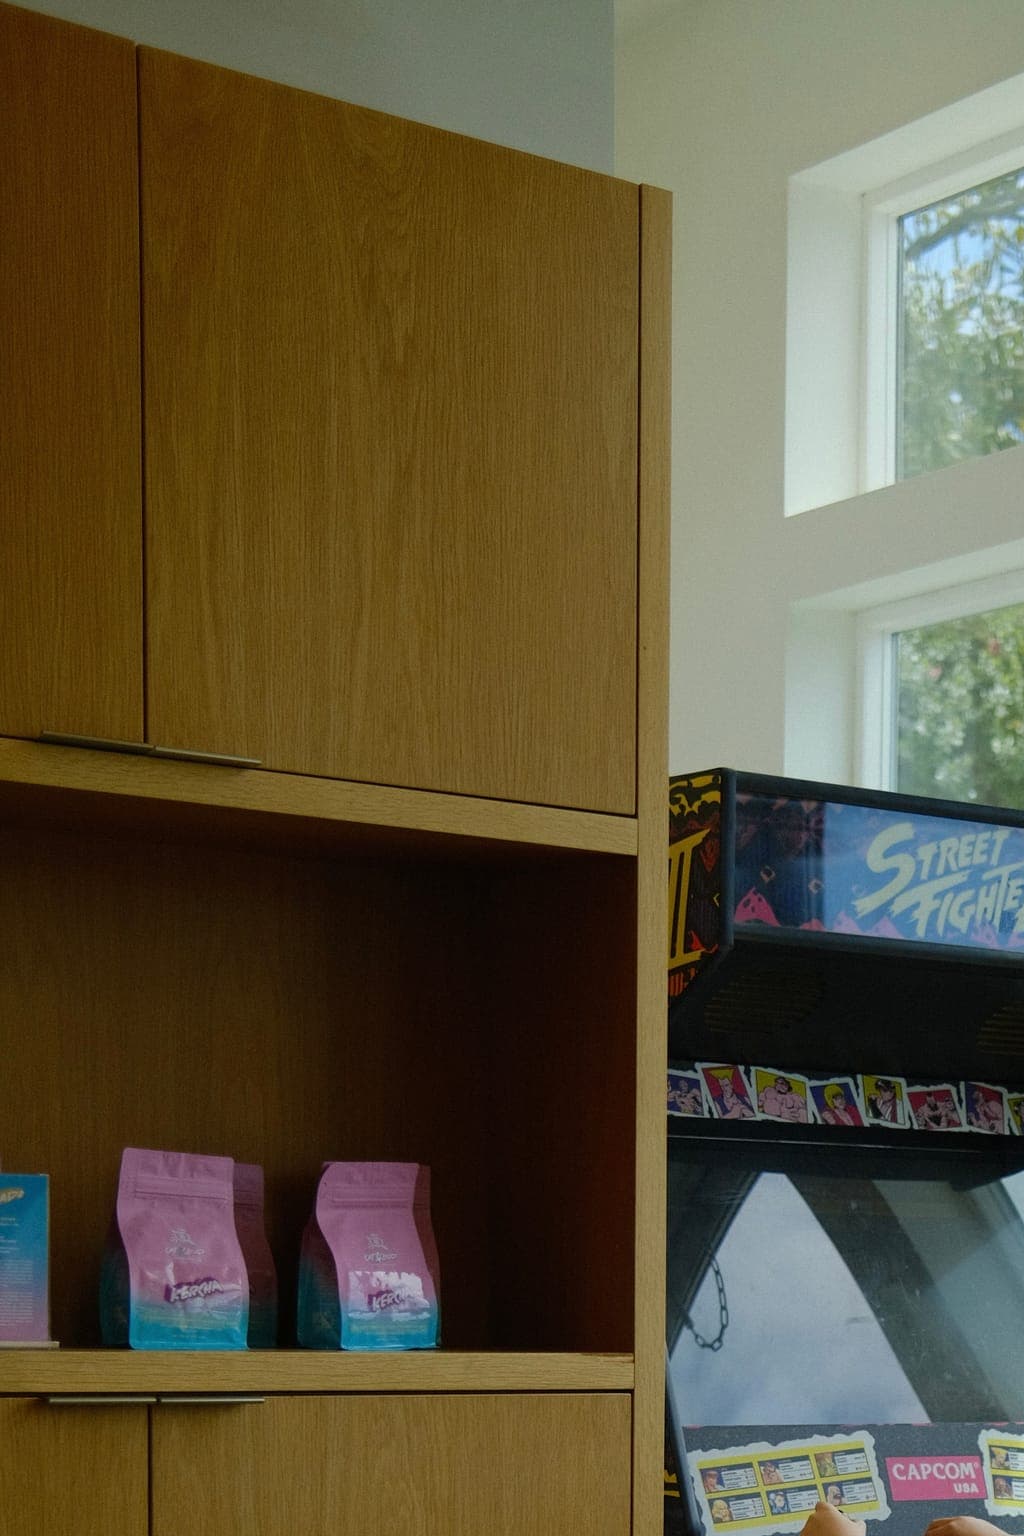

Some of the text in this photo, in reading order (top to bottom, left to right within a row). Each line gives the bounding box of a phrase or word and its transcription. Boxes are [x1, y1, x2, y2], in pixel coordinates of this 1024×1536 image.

[852, 822, 1012, 919] STREET
[892, 1462, 977, 1480] CAPCOM
[953, 1482, 979, 1494] USA
